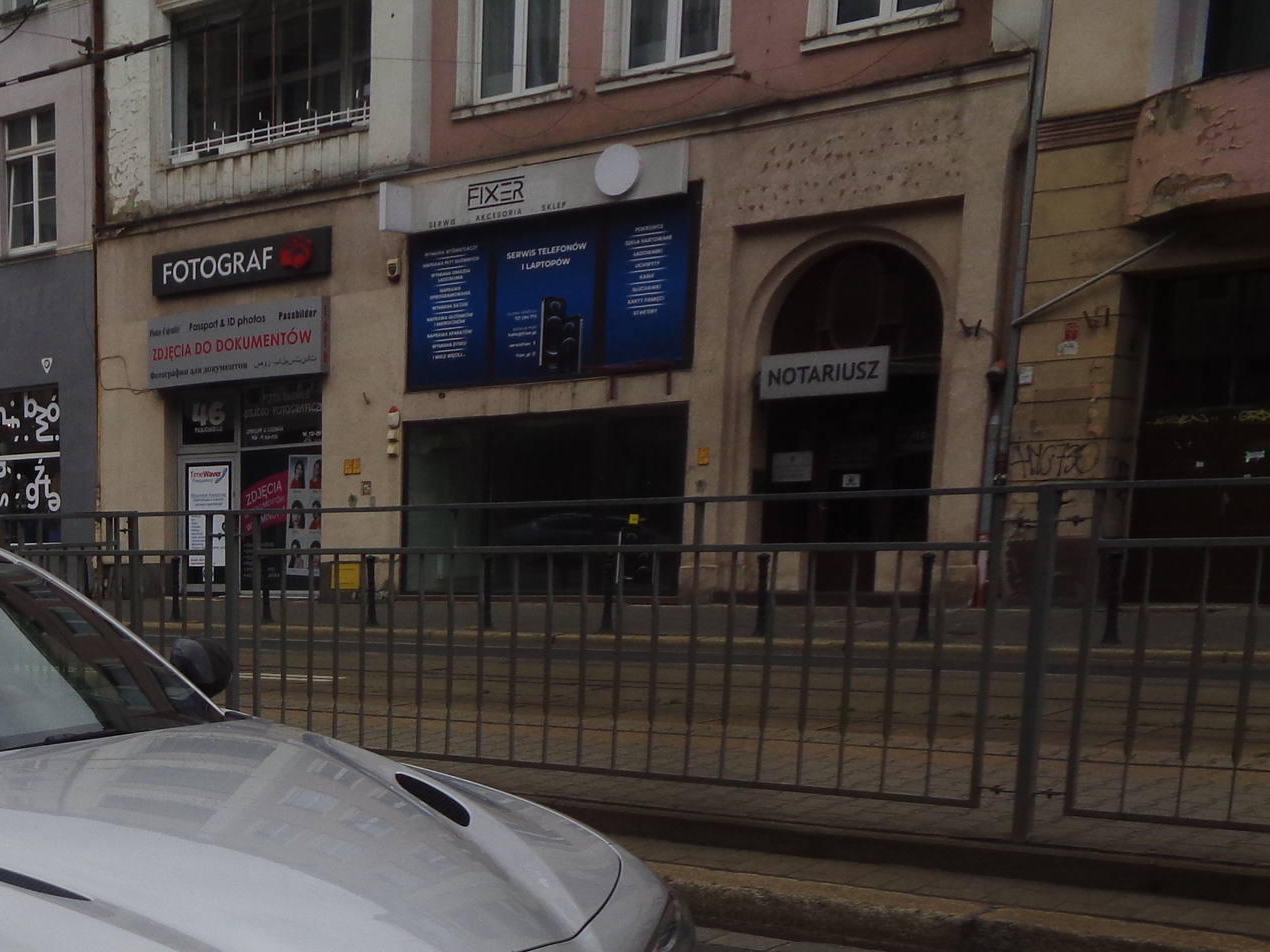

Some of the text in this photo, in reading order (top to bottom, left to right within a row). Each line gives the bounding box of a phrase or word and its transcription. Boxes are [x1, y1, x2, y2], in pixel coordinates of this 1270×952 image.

[468, 180, 524, 206] FIXER
[475, 208, 522, 221] AKCESORIA
[541, 201, 567, 211] SKLEP
[506, 241, 588, 260] SERWIS TELEFONÓW
[162, 246, 274, 285] FOTOGRAF
[521, 257, 571, 271] I LAPTOPÓW
[189, 314, 266, 332] Passport & ID photos
[278, 309, 318, 320] Passbilder
[152, 327, 312, 362] ZDJĘCIA DO DOKUMENTÓW
[203, 362, 248, 374] документов
[768, 360, 880, 386] NOTARIUSZ
[191, 401, 226, 426] 46
[243, 402, 322, 419] STUDIO FOTOGRAFICZ
[190, 470, 222, 478] TimeWaver
[245, 480, 283, 507] ZDJĘCIA
